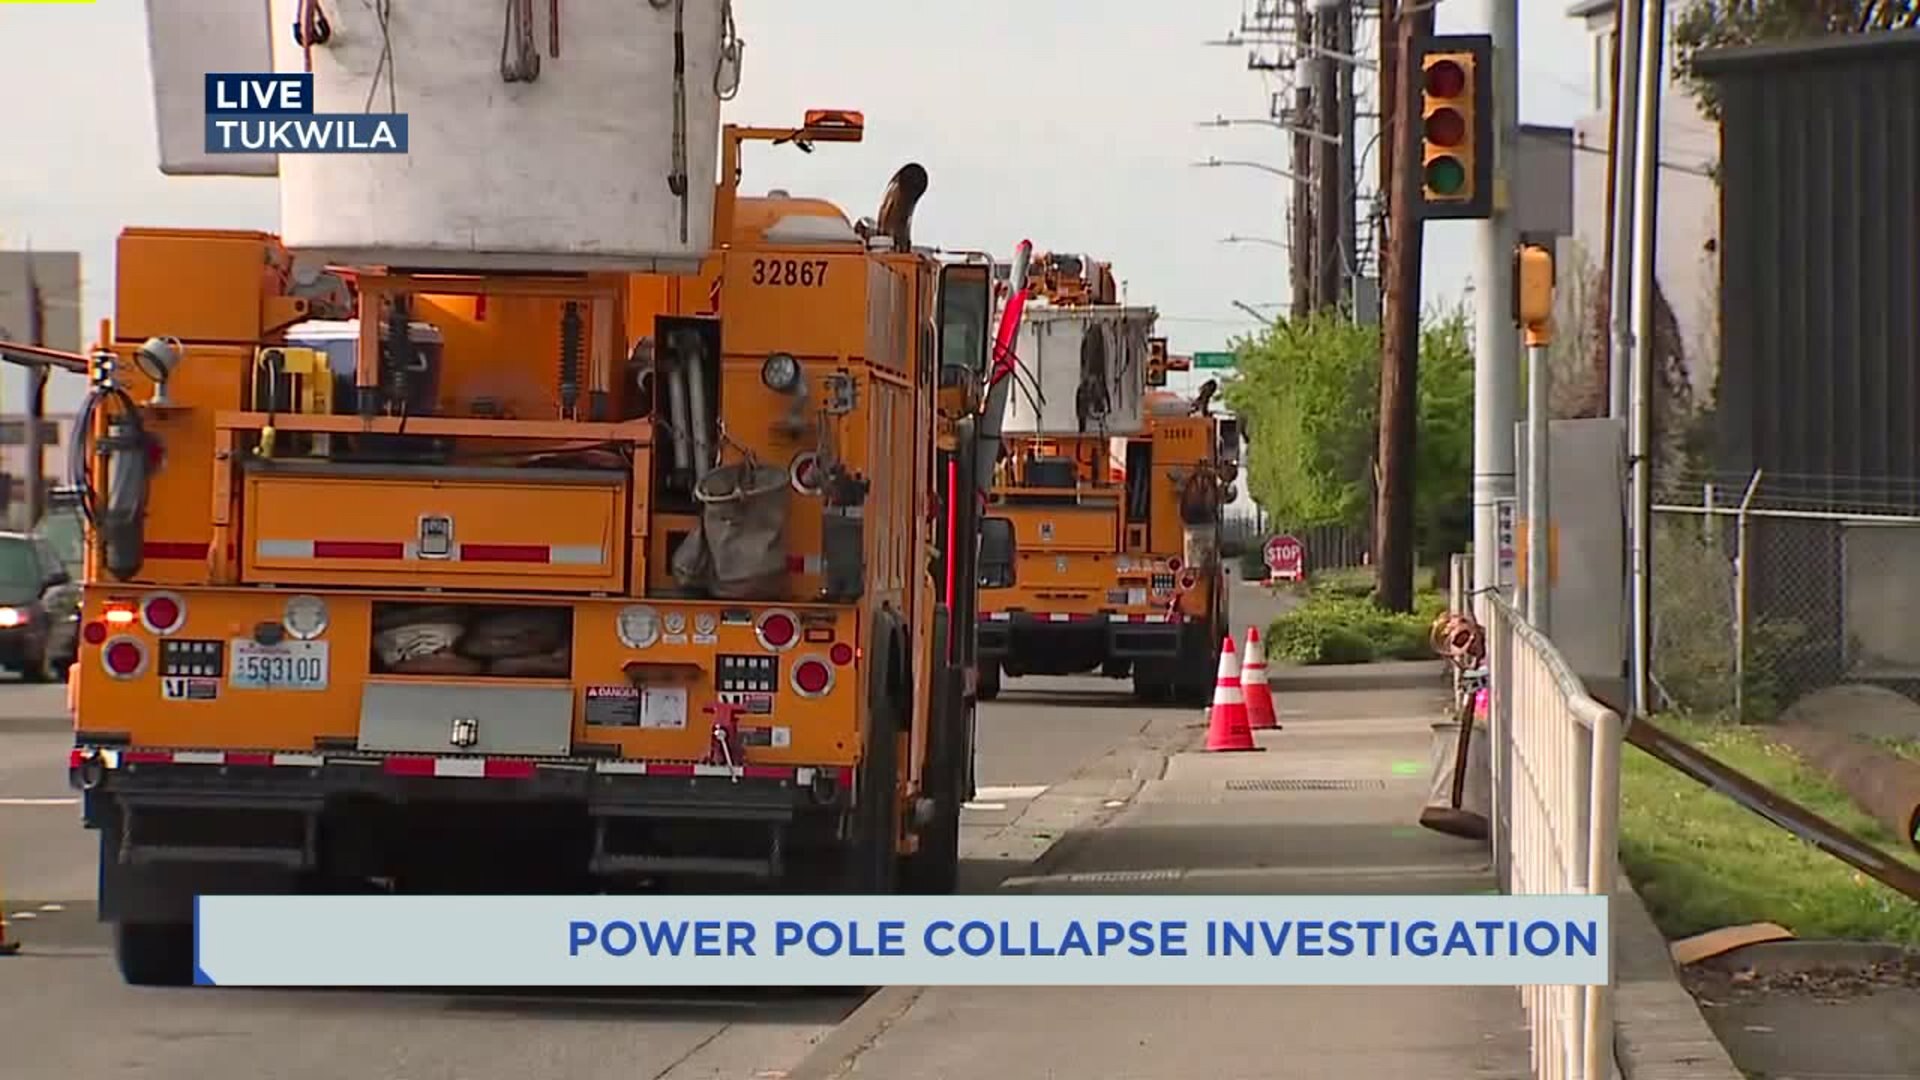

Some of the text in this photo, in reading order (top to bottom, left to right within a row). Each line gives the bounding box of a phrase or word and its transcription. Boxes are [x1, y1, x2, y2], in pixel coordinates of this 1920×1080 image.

[752, 259, 829, 287] 32867
[1268, 545, 1300, 561] STOP
[598, 687, 638, 698] DANGER
